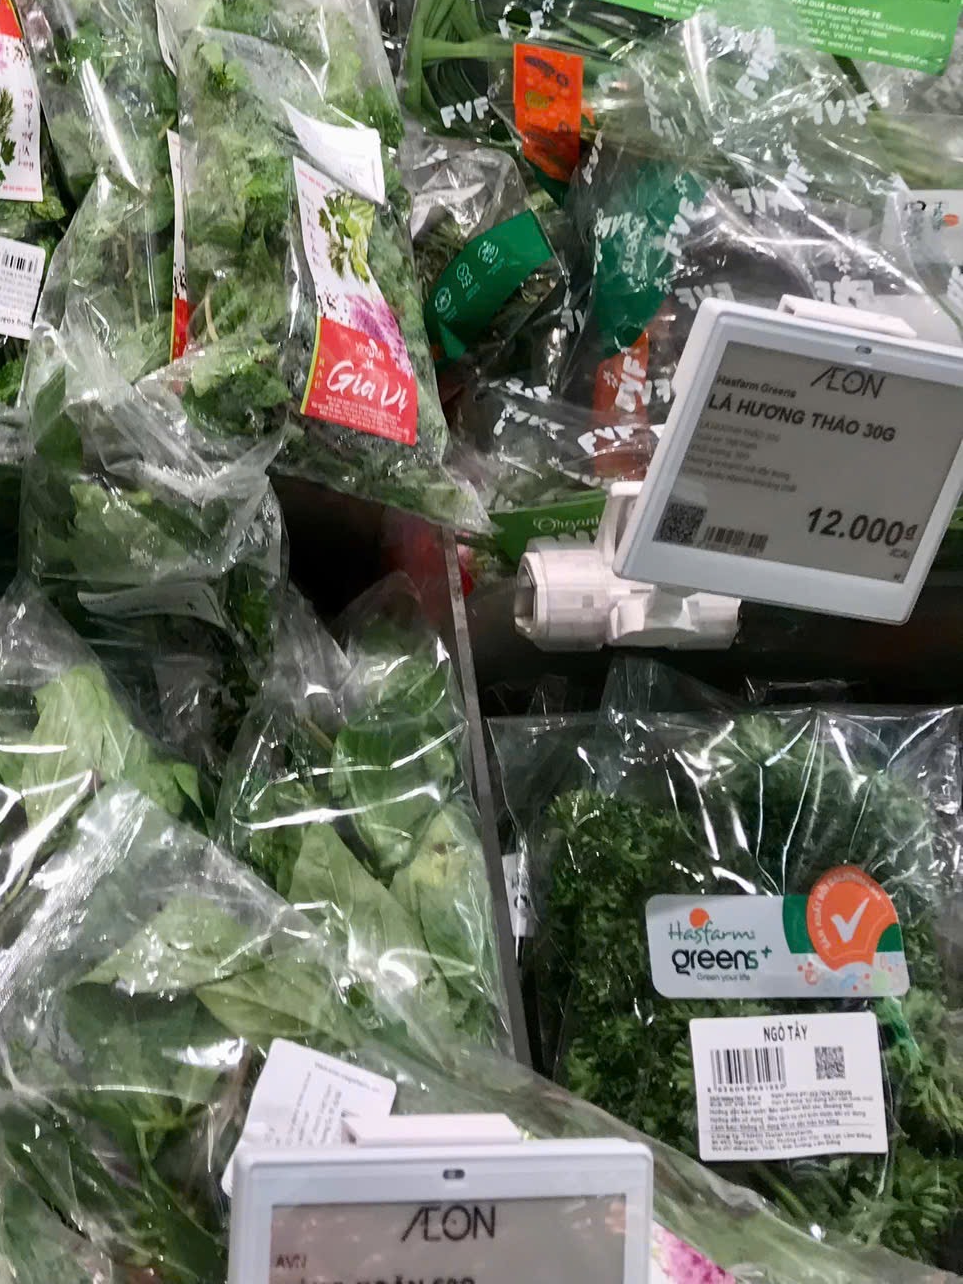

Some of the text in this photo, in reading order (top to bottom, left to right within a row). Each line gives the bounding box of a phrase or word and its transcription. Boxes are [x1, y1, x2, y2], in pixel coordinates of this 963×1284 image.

[440, 97, 489, 128] FVF
[717, 375, 797, 398] Hasfarm Greens
[708, 393, 733, 412] LÁ
[737, 398, 806, 425] HƯƠNG
[863, 422, 896, 442] 30G
[669, 920, 755, 946] Hasfarm
[763, 1022, 785, 1042] NGÒ
